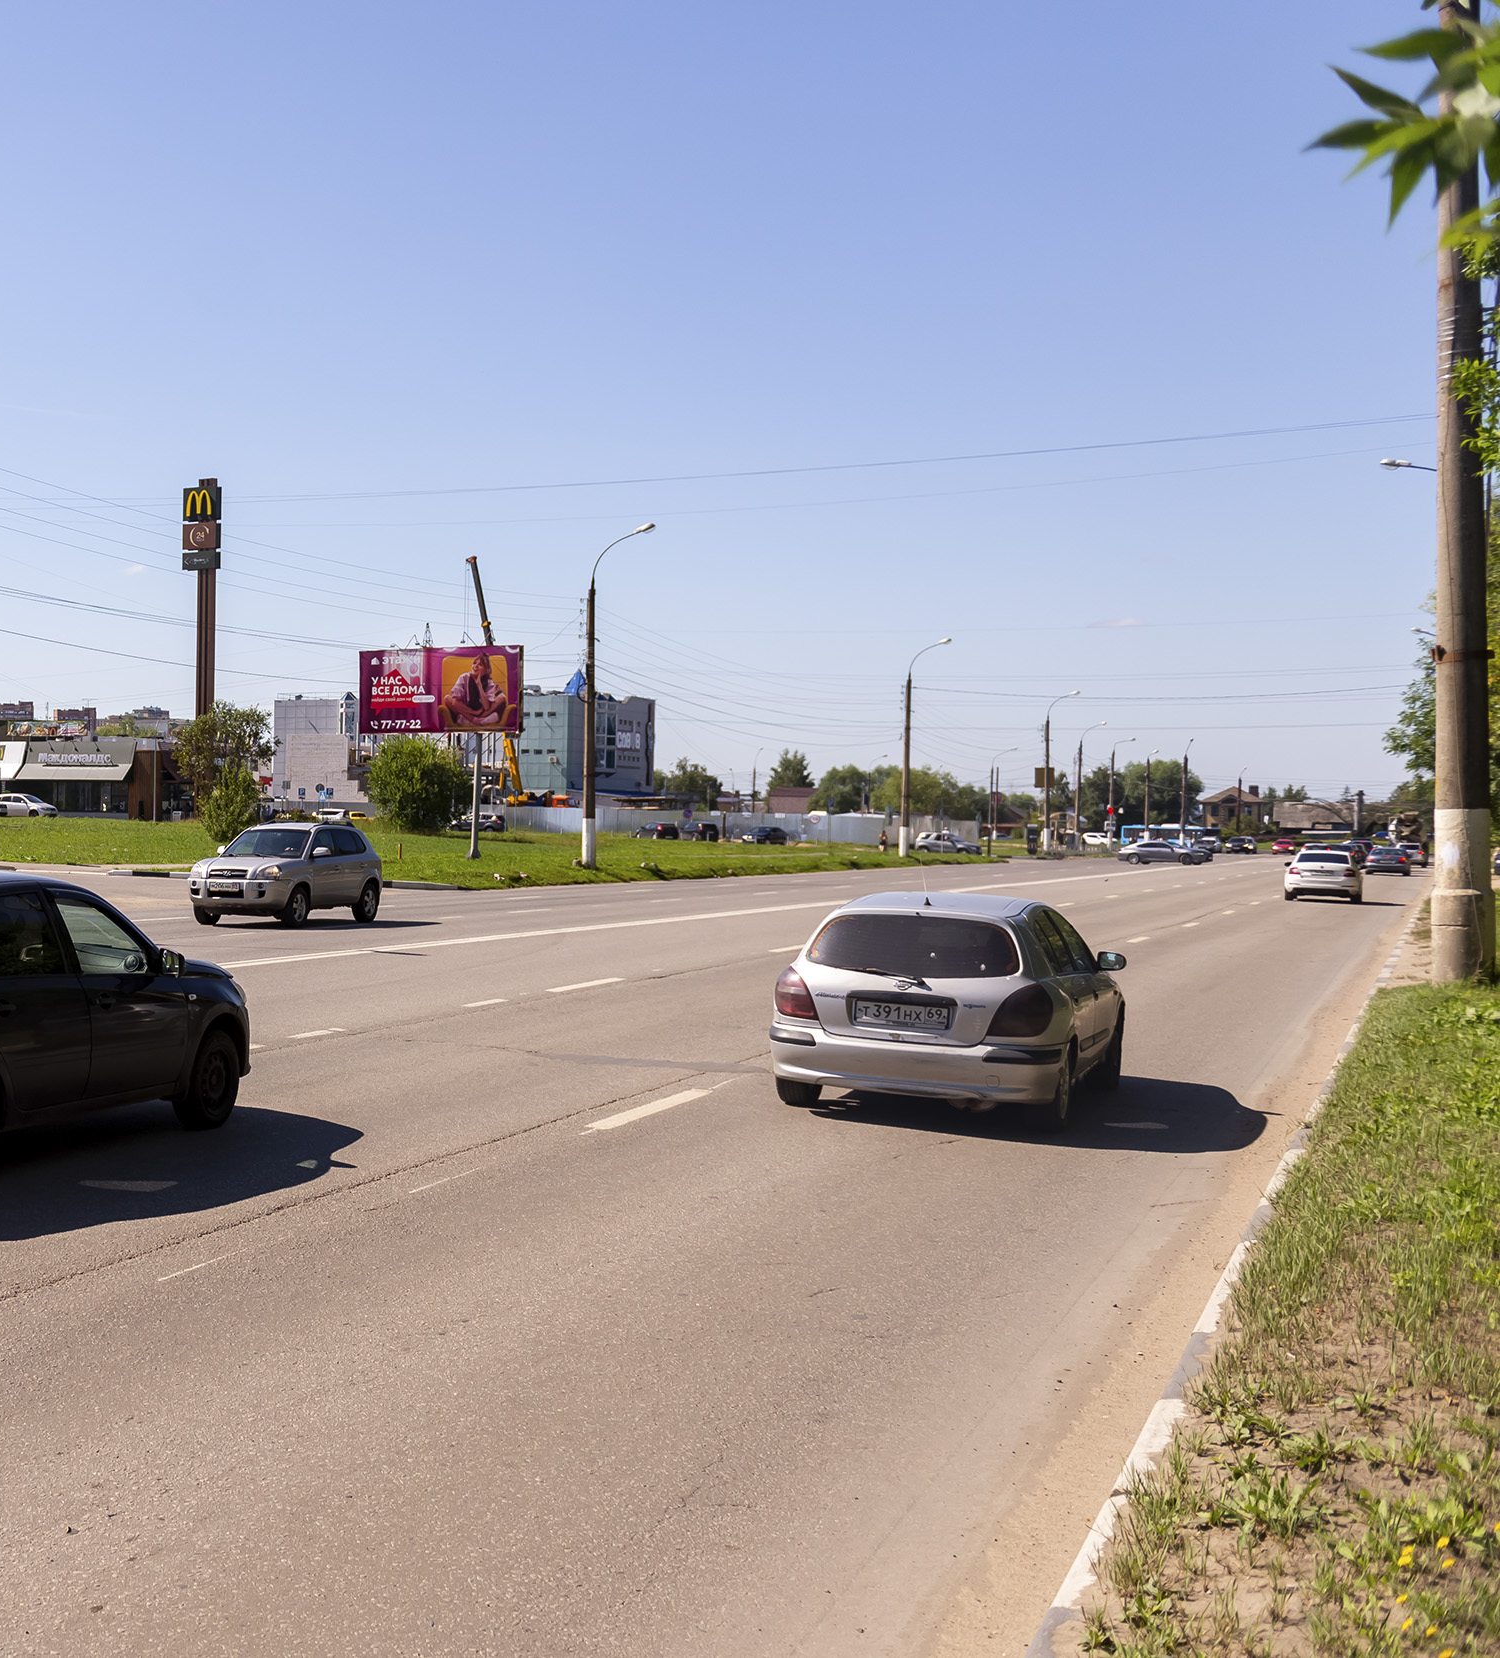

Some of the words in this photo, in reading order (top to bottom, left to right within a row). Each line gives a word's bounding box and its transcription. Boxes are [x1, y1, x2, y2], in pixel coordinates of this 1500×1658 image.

[196, 531, 205, 539] 24
[371, 676, 379, 685] У
[380, 676, 403, 685] НАС
[371, 686, 391, 696] ВСЕ
[380, 719, 422, 730] 77-77-22
[37, 752, 112, 764] Макдоналдс
[862, 1004, 923, 1022] Т391НХ
[926, 1008, 943, 1019] 69
